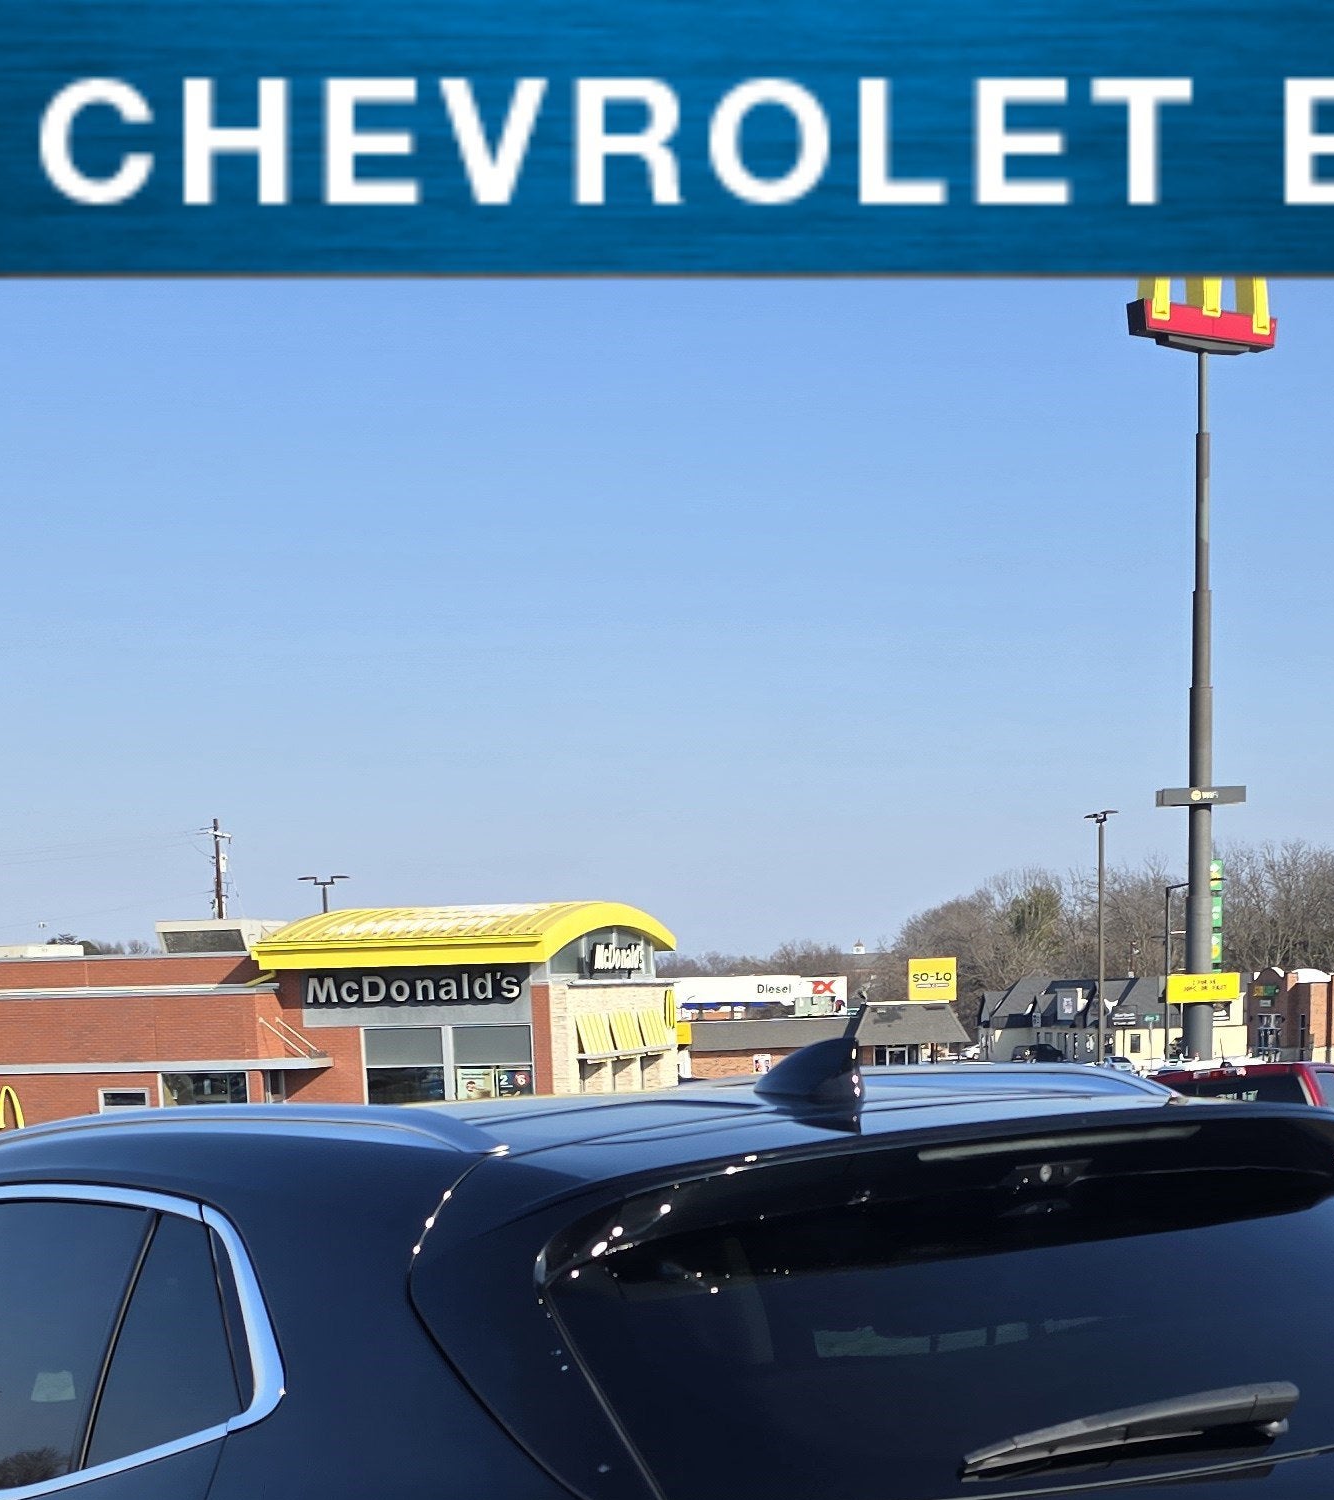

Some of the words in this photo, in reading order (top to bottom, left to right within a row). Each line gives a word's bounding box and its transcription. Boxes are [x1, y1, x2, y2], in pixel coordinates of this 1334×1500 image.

[593, 944, 645, 970] McDonald's
[912, 972, 952, 983] SO-LO
[305, 972, 520, 1005] McDonald's
[756, 983, 792, 995] Diesel
